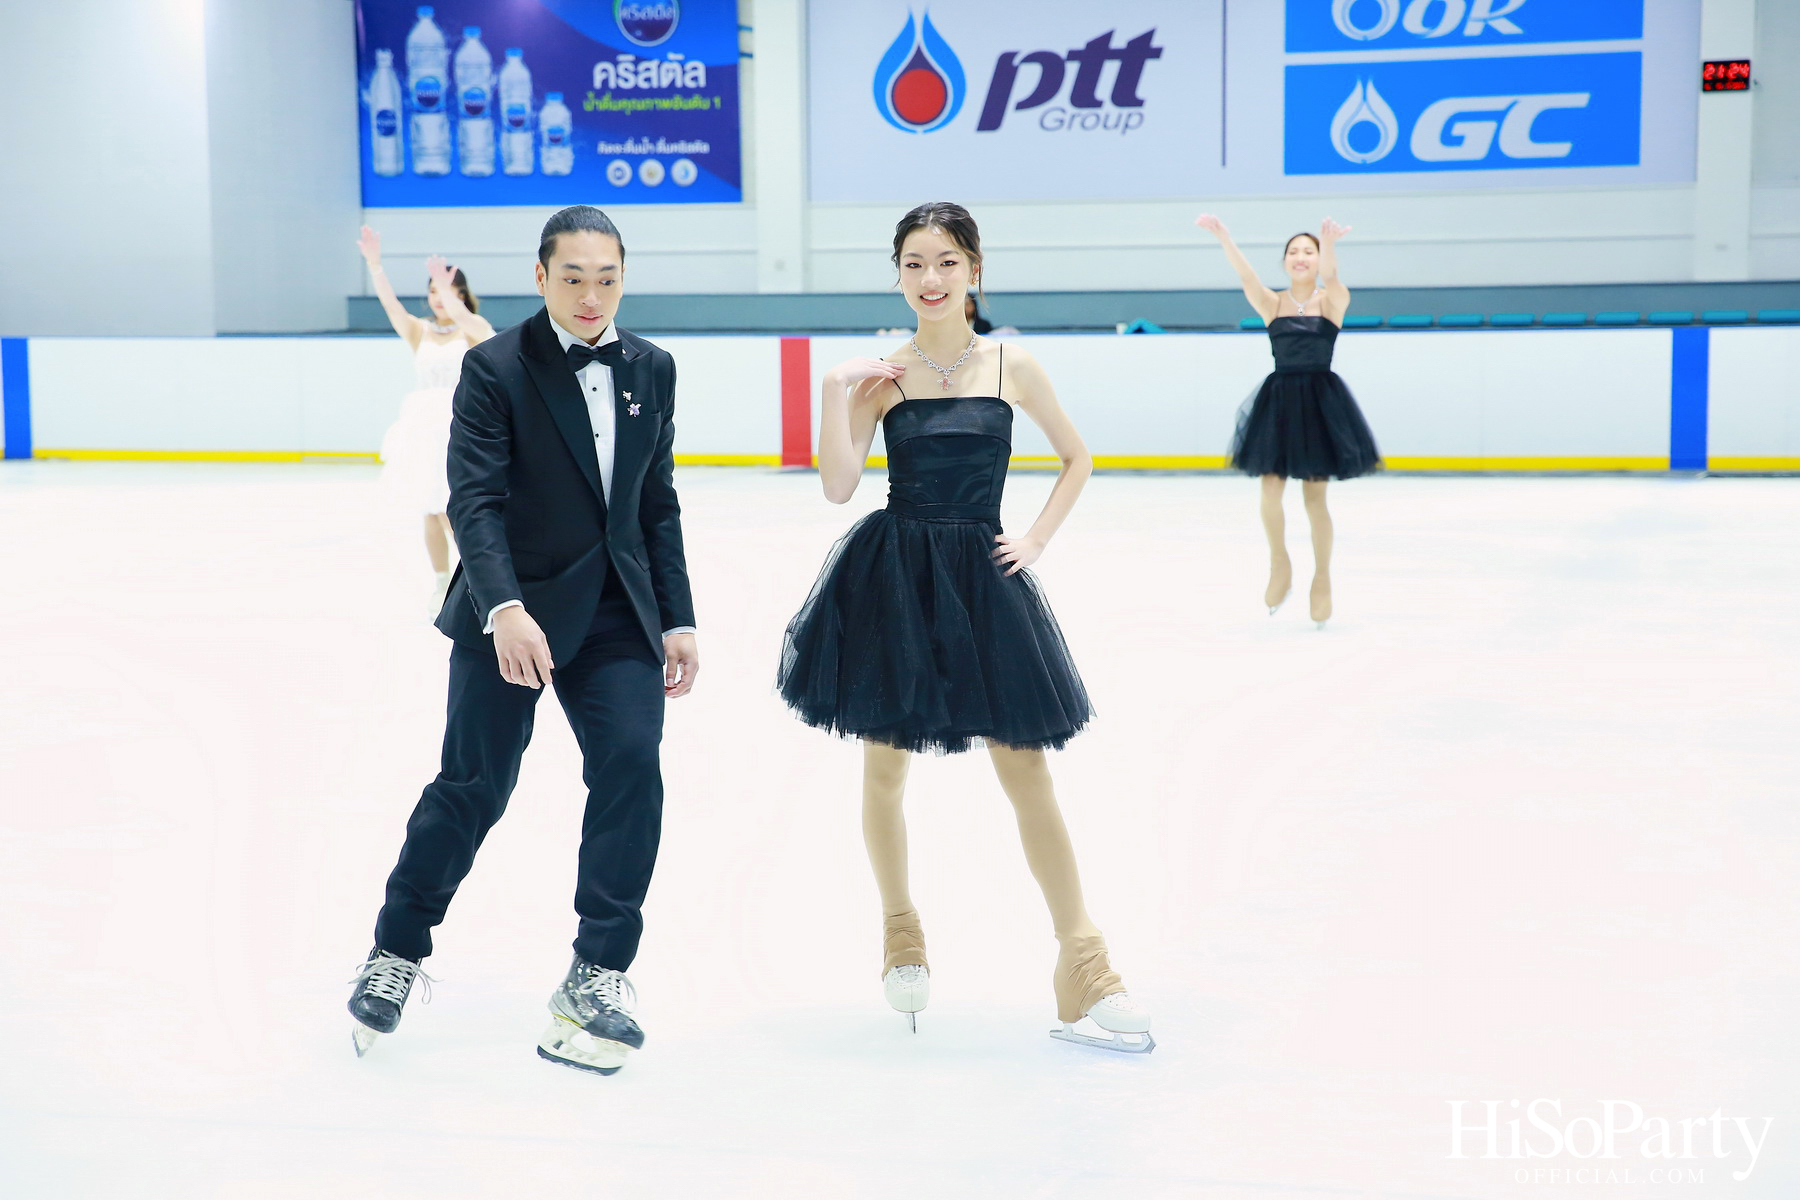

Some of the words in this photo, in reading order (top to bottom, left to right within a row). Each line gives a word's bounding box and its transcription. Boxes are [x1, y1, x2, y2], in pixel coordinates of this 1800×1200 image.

[593, 52, 706, 89] คริสตัล
[976, 27, 1164, 132] ptt
[1039, 106, 1145, 135] Group
[1410, 92, 1591, 162] GC
